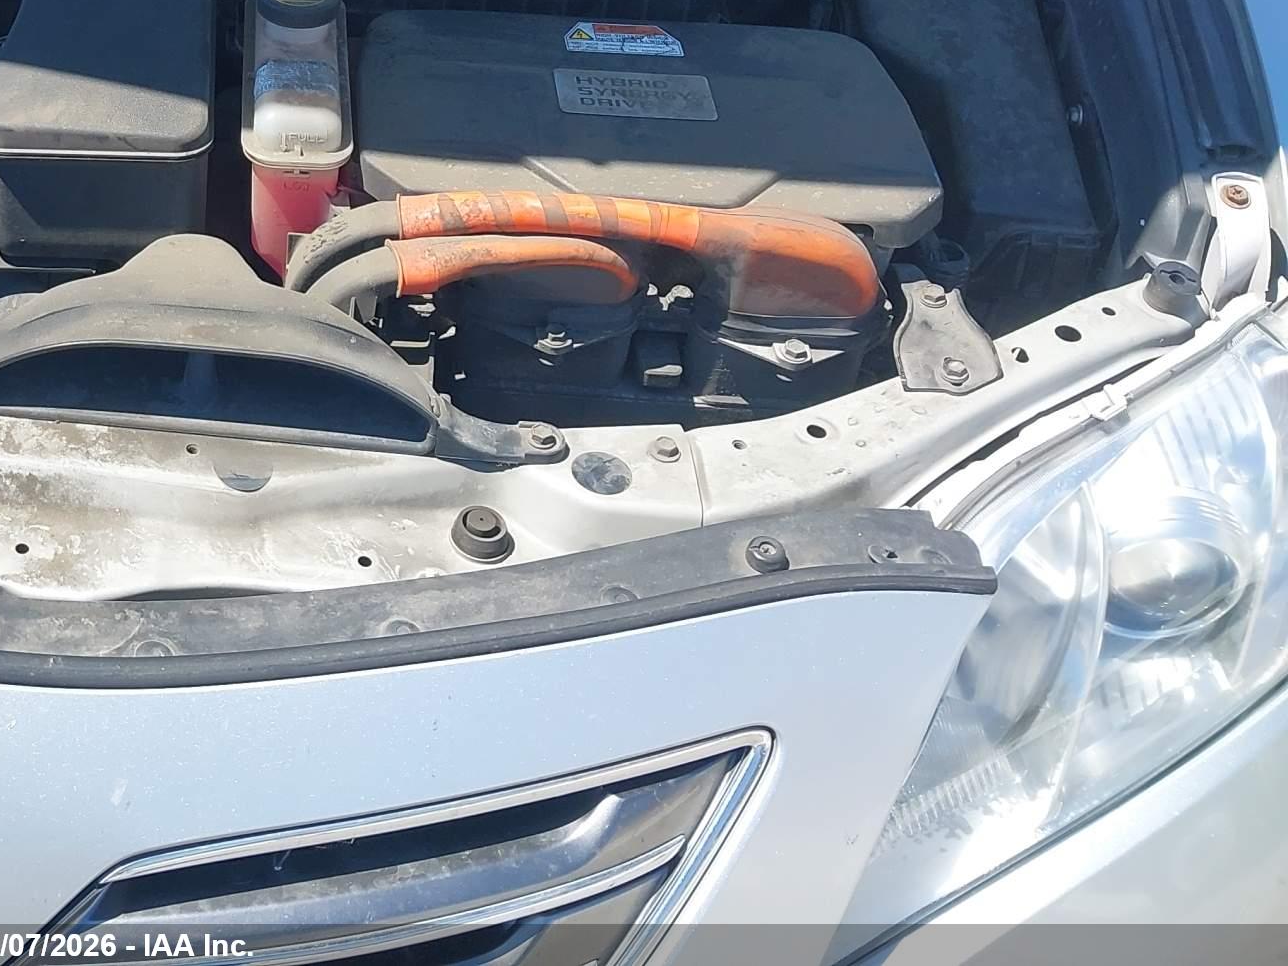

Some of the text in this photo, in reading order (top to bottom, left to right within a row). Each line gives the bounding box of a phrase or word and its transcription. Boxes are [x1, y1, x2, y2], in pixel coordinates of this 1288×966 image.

[575, 76, 669, 88] HYBRID
[578, 86, 691, 100] SYNERGY
[287, 132, 328, 143] FULL
